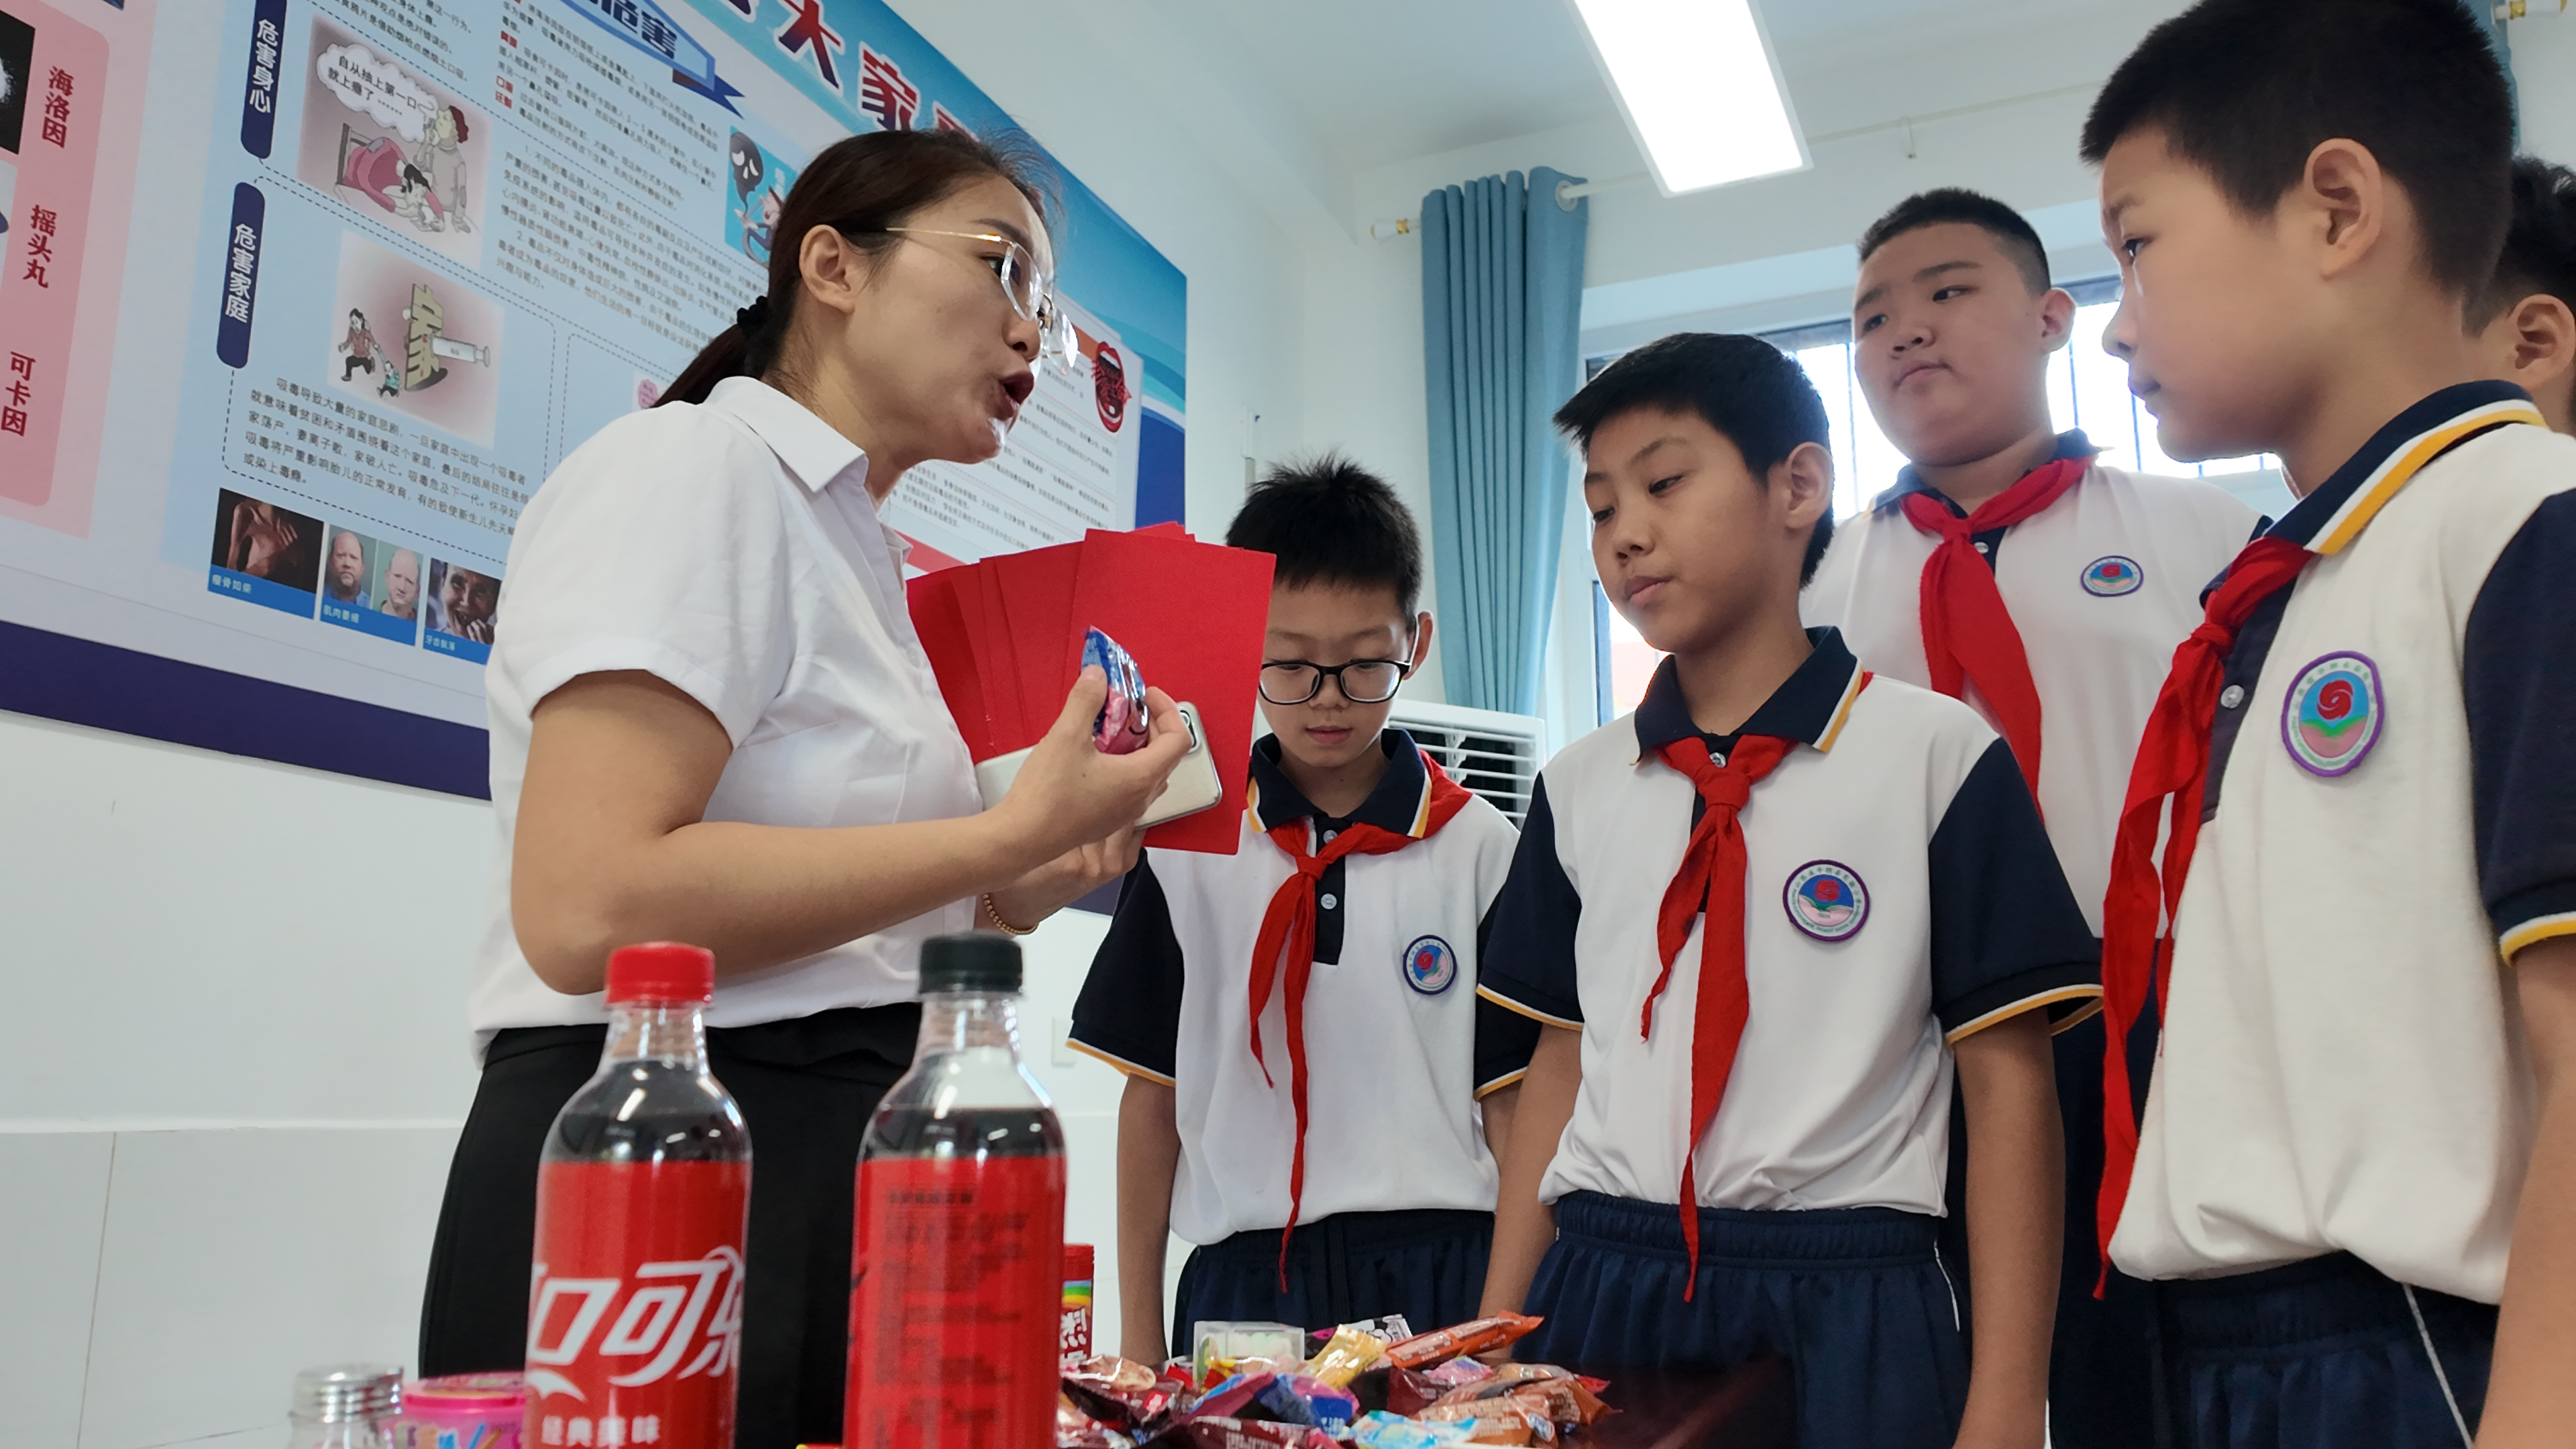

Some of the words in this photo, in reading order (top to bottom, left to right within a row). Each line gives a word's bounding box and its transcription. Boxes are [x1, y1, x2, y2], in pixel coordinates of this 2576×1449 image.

[249, 19, 280, 113] 危害身心
[586, 0, 678, 59] 危害
[42, 66, 74, 149] 海洛因
[338, 55, 417, 109] 自从抽上第一口
[23, 204, 58, 288] 摇头丸
[225, 224, 256, 323] 危害家庭
[1, 350, 36, 437] 可卡因
[243, 451, 307, 484] 或染上毒瘾。
[527, 1244, 745, 1387] 口可乐
